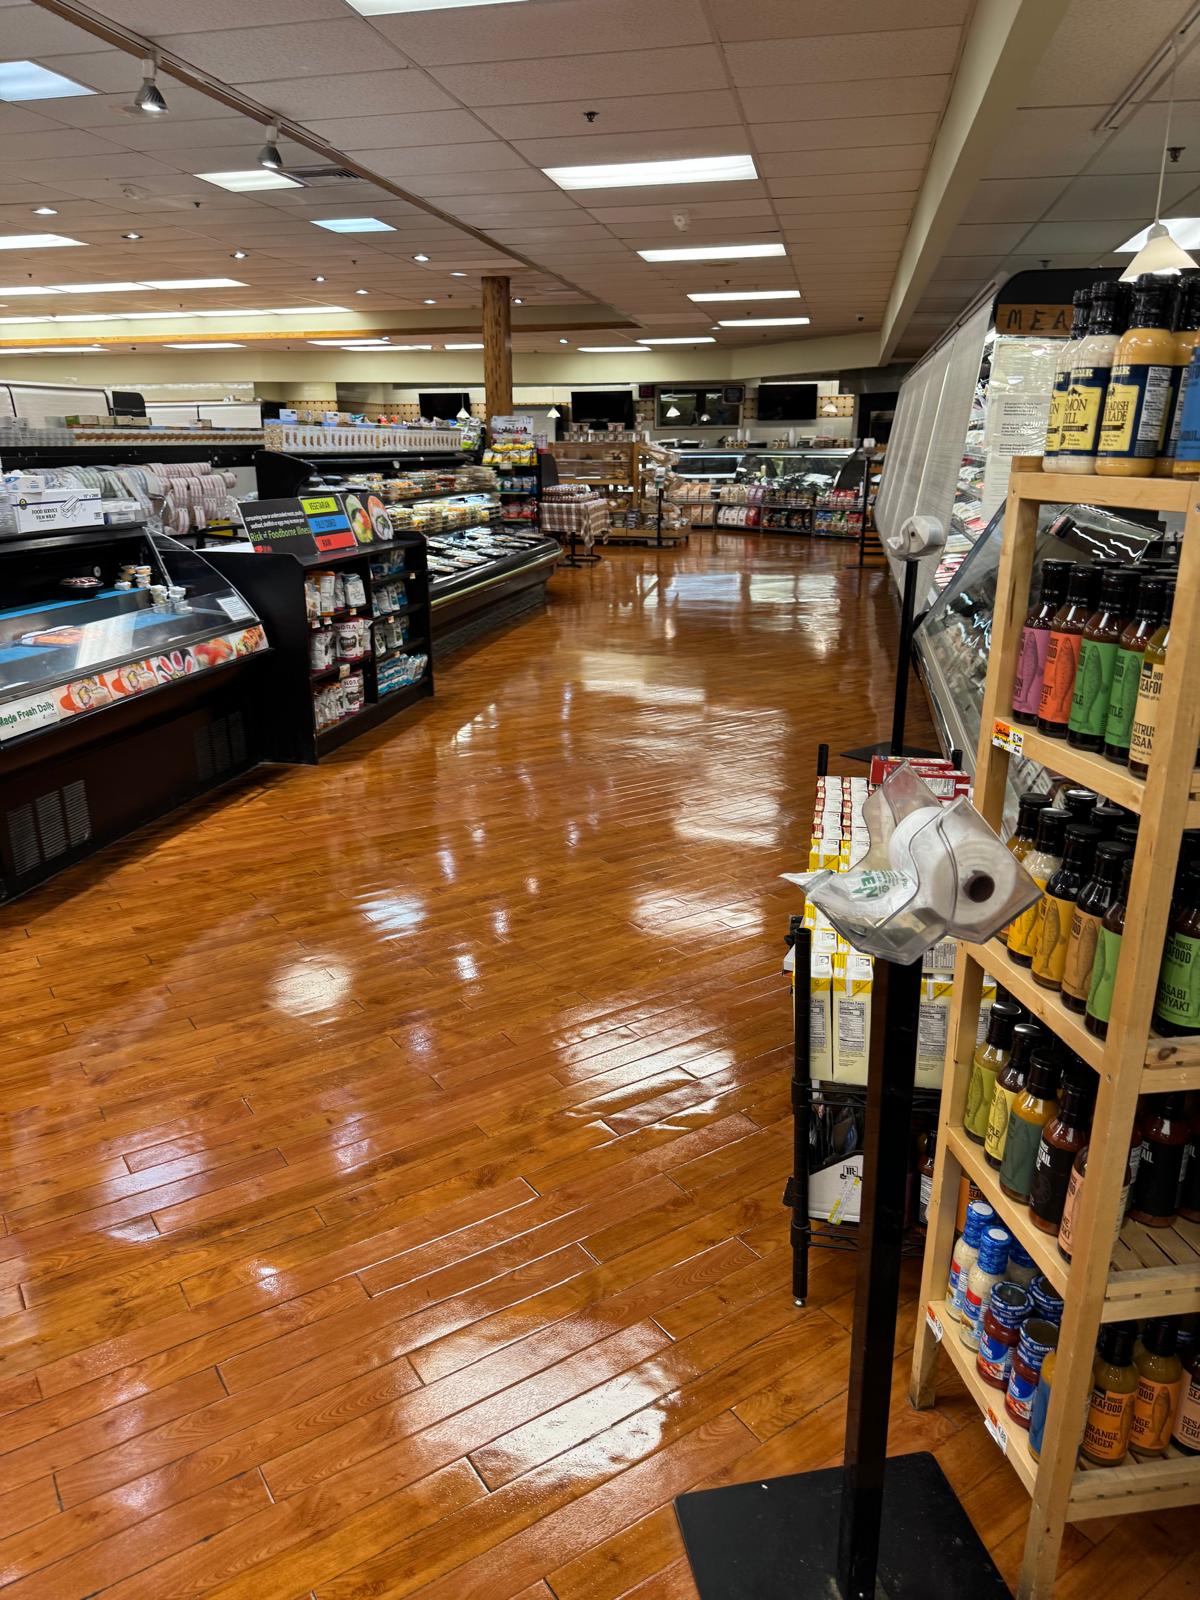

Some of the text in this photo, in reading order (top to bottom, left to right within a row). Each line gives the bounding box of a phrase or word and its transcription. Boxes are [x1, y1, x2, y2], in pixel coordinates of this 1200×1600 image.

[250, 532, 264, 542] Risk
[17, 706, 38, 720] Fresh
[37, 701, 54, 714] Daily
